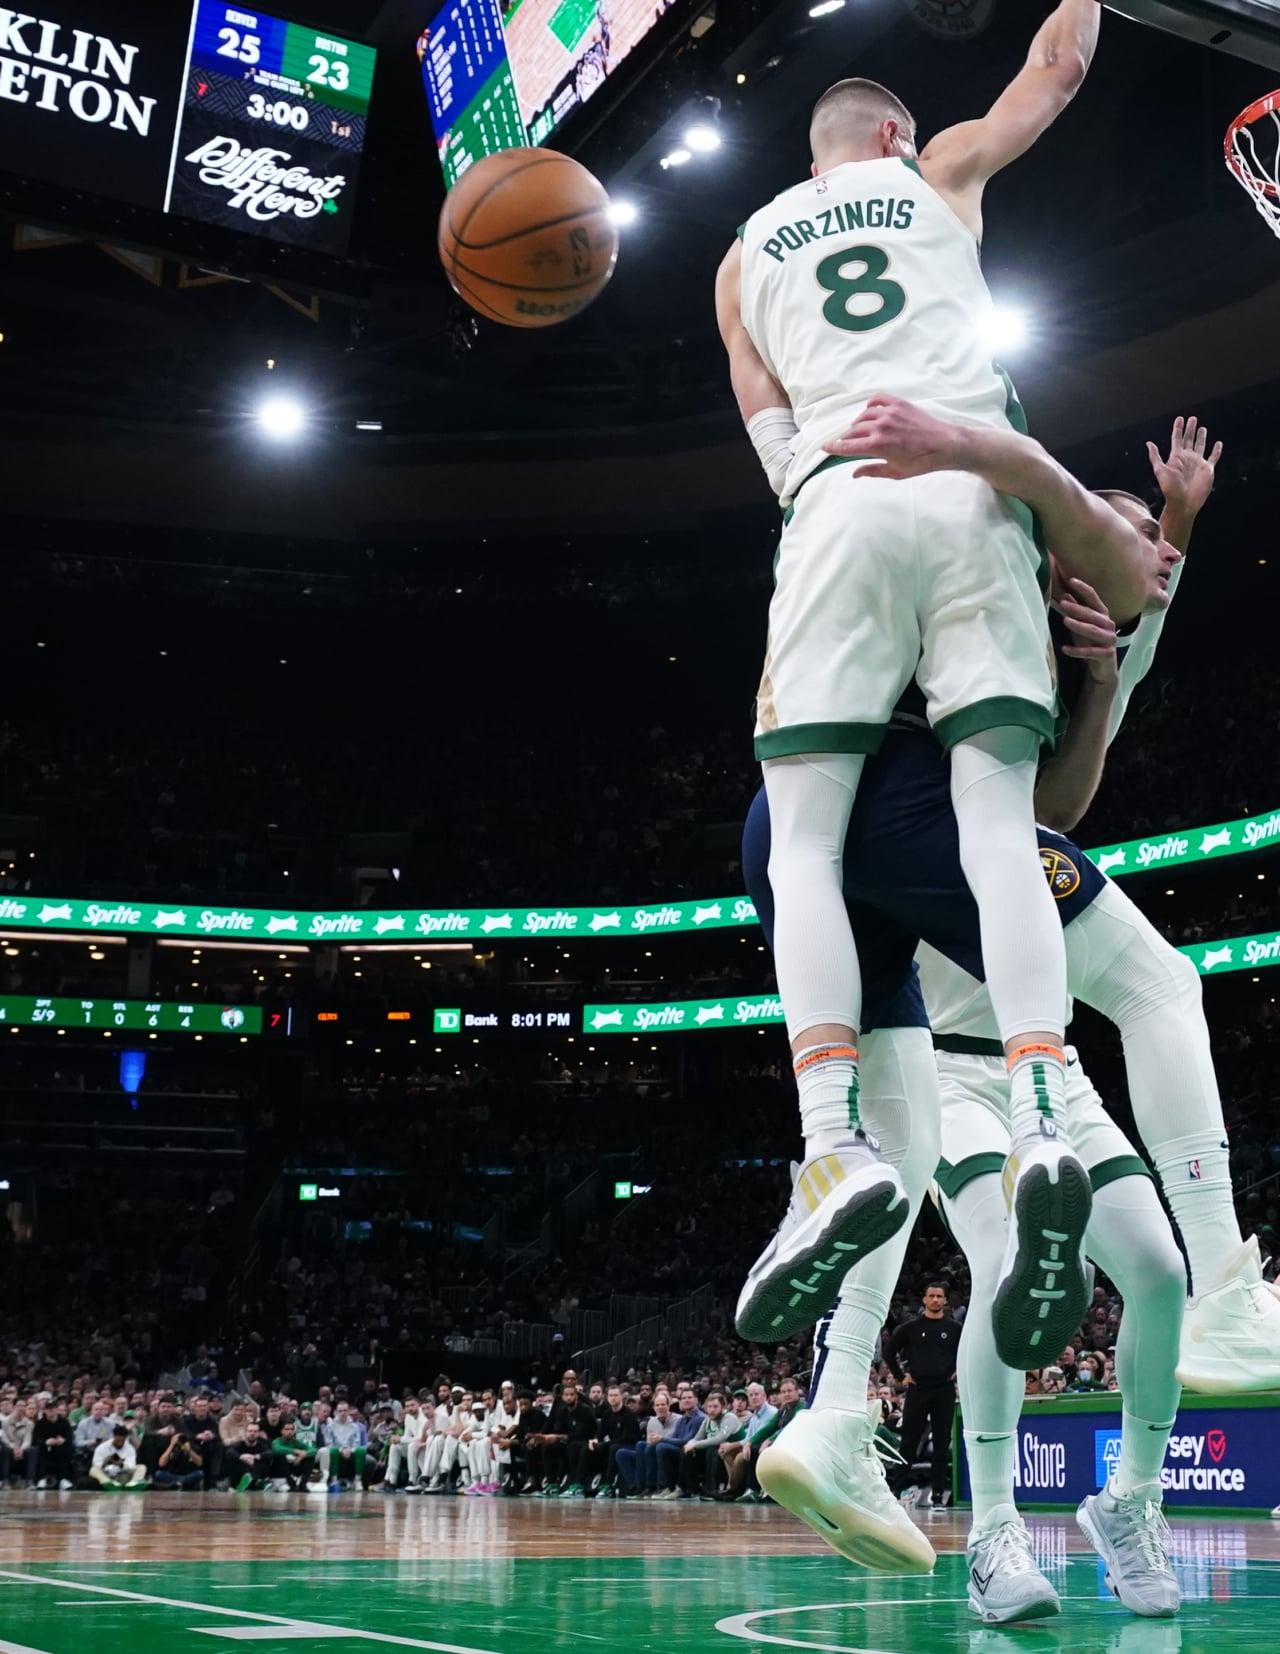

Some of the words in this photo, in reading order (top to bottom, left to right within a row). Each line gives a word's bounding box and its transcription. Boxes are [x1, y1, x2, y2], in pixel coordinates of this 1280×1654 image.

[0, 7, 139, 85] KLIN
[216, 27, 261, 64] 25
[306, 54, 350, 91] 23
[0, 56, 157, 137] ETON
[247, 94, 309, 130] 3:00
[185, 135, 346, 199] Different
[203, 169, 323, 221] Here
[762, 198, 915, 263] PORZINGIS
[815, 245, 907, 333] 8
[1136, 838, 1188, 866] Sprite
[83, 905, 141, 926] Sprite
[197, 911, 253, 931] Sprite
[309, 915, 362, 936] Sprite
[415, 913, 469, 934] Sprite
[523, 912, 577, 932] Sprite
[632, 908, 681, 930] Sprite
[32, 1008, 56, 1022] 5/9
[84, 1011, 91, 1023] 1
[114, 1013, 125, 1025] 0
[148, 1015, 158, 1026] 6
[180, 1017, 190, 1027] 4
[271, 1014, 281, 1027] 7
[437, 1012, 458, 1028] TD
[464, 1013, 498, 1027] Bank
[511, 1012, 542, 1027] 8:01
[547, 1012, 571, 1027] PM
[633, 1007, 685, 1030] Sprite
[1023, 1432, 1066, 1489] Store
[1168, 1435, 1205, 1466] sey
